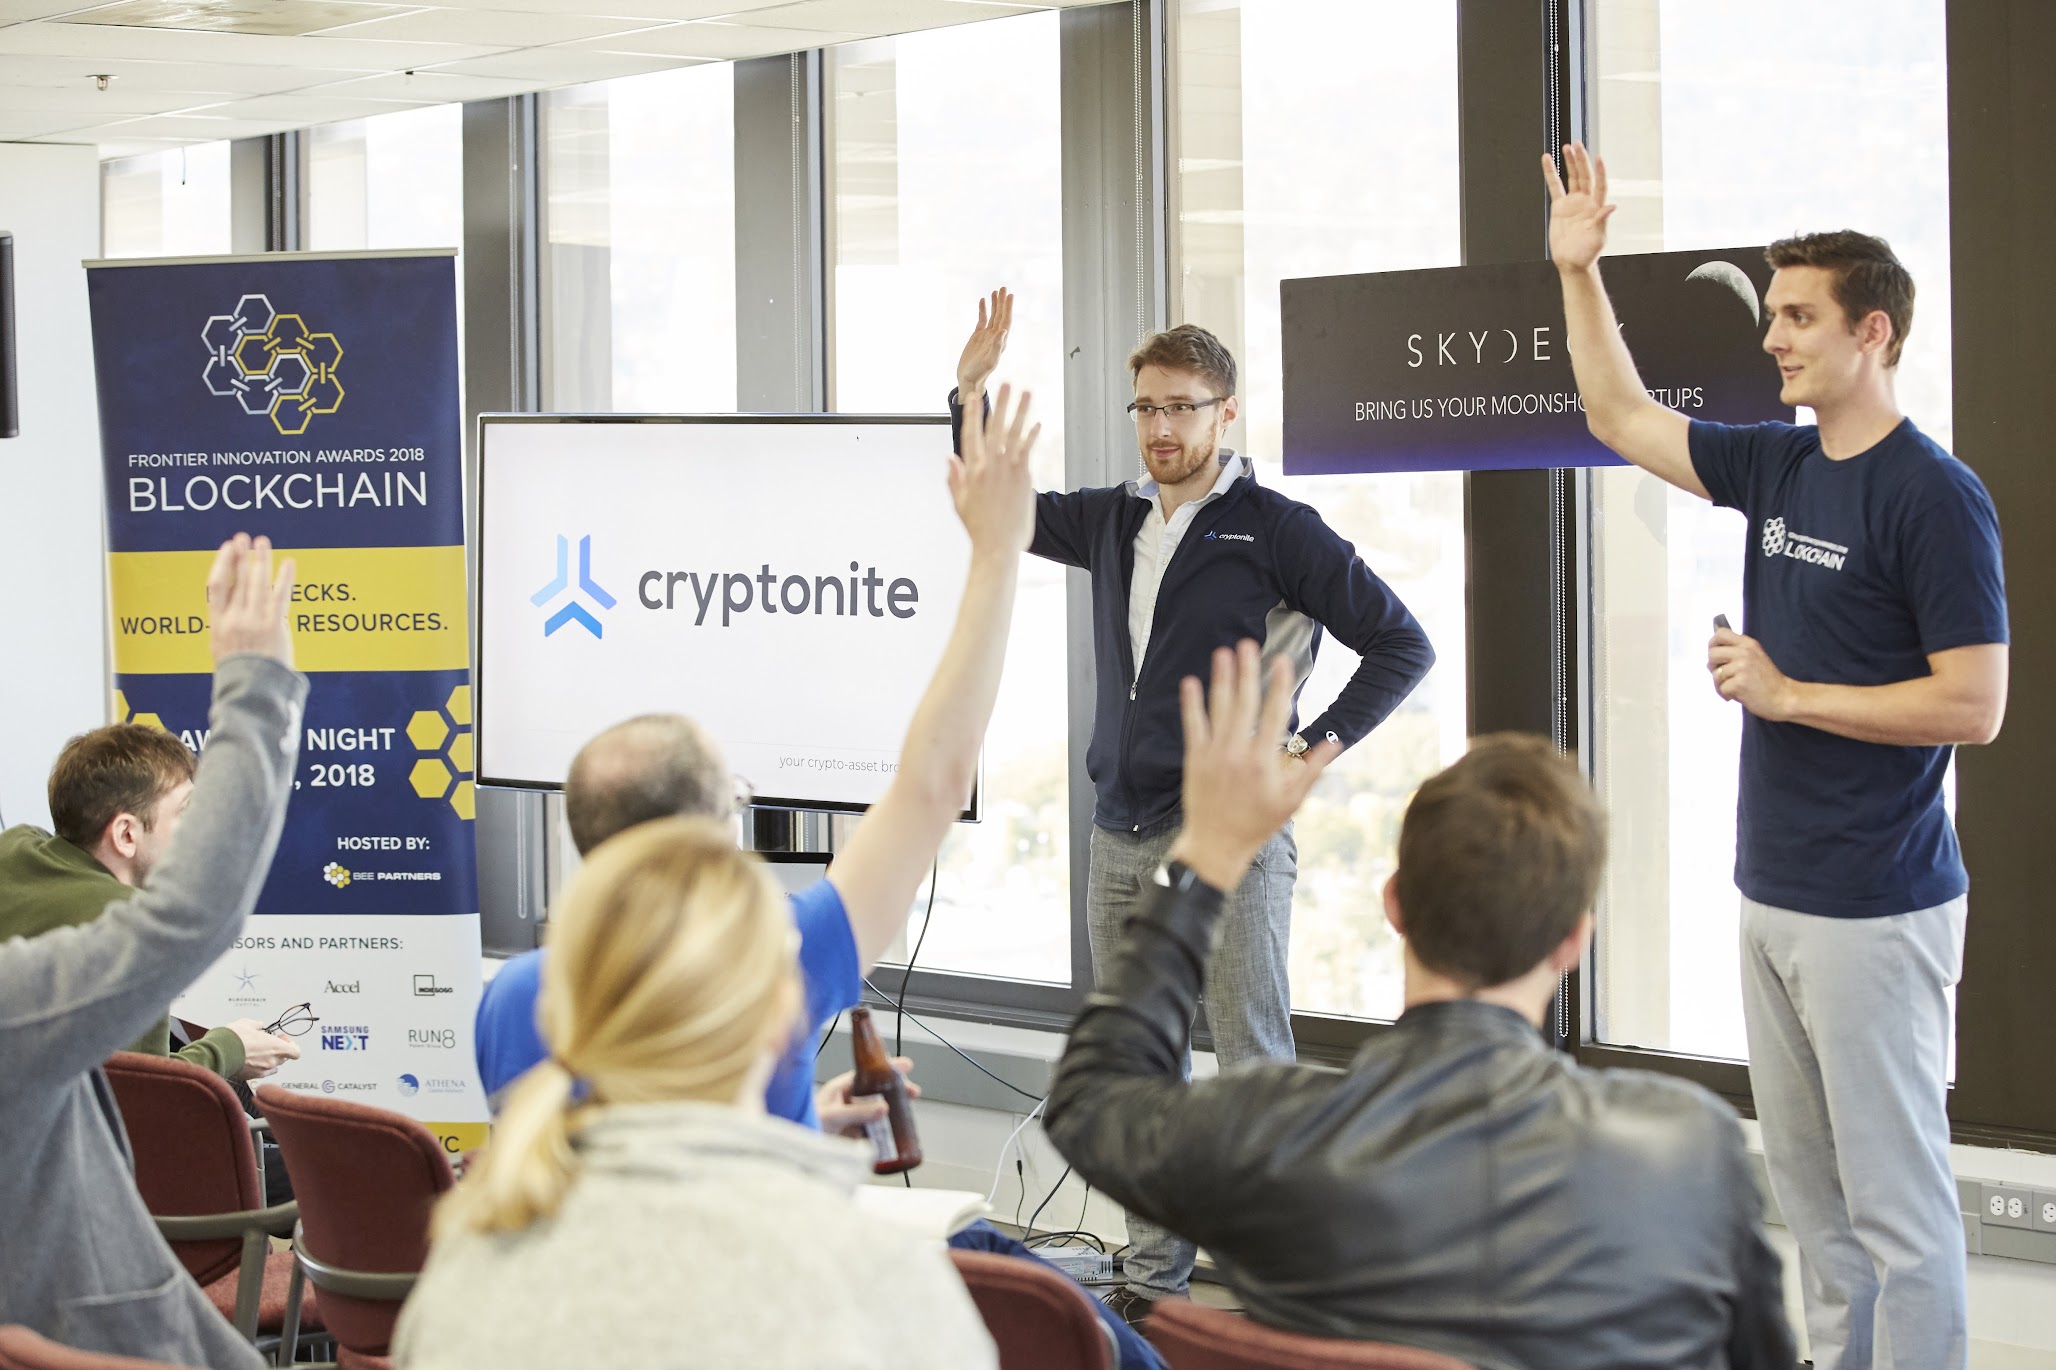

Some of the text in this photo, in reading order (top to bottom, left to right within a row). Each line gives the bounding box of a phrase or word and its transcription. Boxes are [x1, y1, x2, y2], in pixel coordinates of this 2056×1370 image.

[1355, 401, 1406, 422] BRING
[1411, 399, 1434, 419] US
[1437, 396, 1487, 418] YOUR
[128, 447, 425, 467] FRONTIER INNOVATION AWARDS 2018
[129, 471, 427, 512] BLOCKCHAIN
[1219, 533, 1254, 542] cryptonite
[273, 583, 356, 602] ECKS.
[638, 560, 919, 627] cryptonite
[121, 613, 448, 635] WORLD- RESOURCES.
[307, 728, 395, 751] NIGHT
[779, 756, 901, 773] your crypto-asset bro
[310, 764, 375, 787] 2018
[337, 836, 430, 851] HOSTED BY:
[352, 872, 442, 881] BEE PARTNERS
[231, 937, 403, 950] SORS AND PARTNERS:
[323, 980, 360, 993] Accel
[321, 1025, 369, 1034] SAMSUNG
[321, 1035, 369, 1051] NEXT
[408, 1029, 456, 1049] RUN8
[425, 1079, 466, 1088] ATHENA
